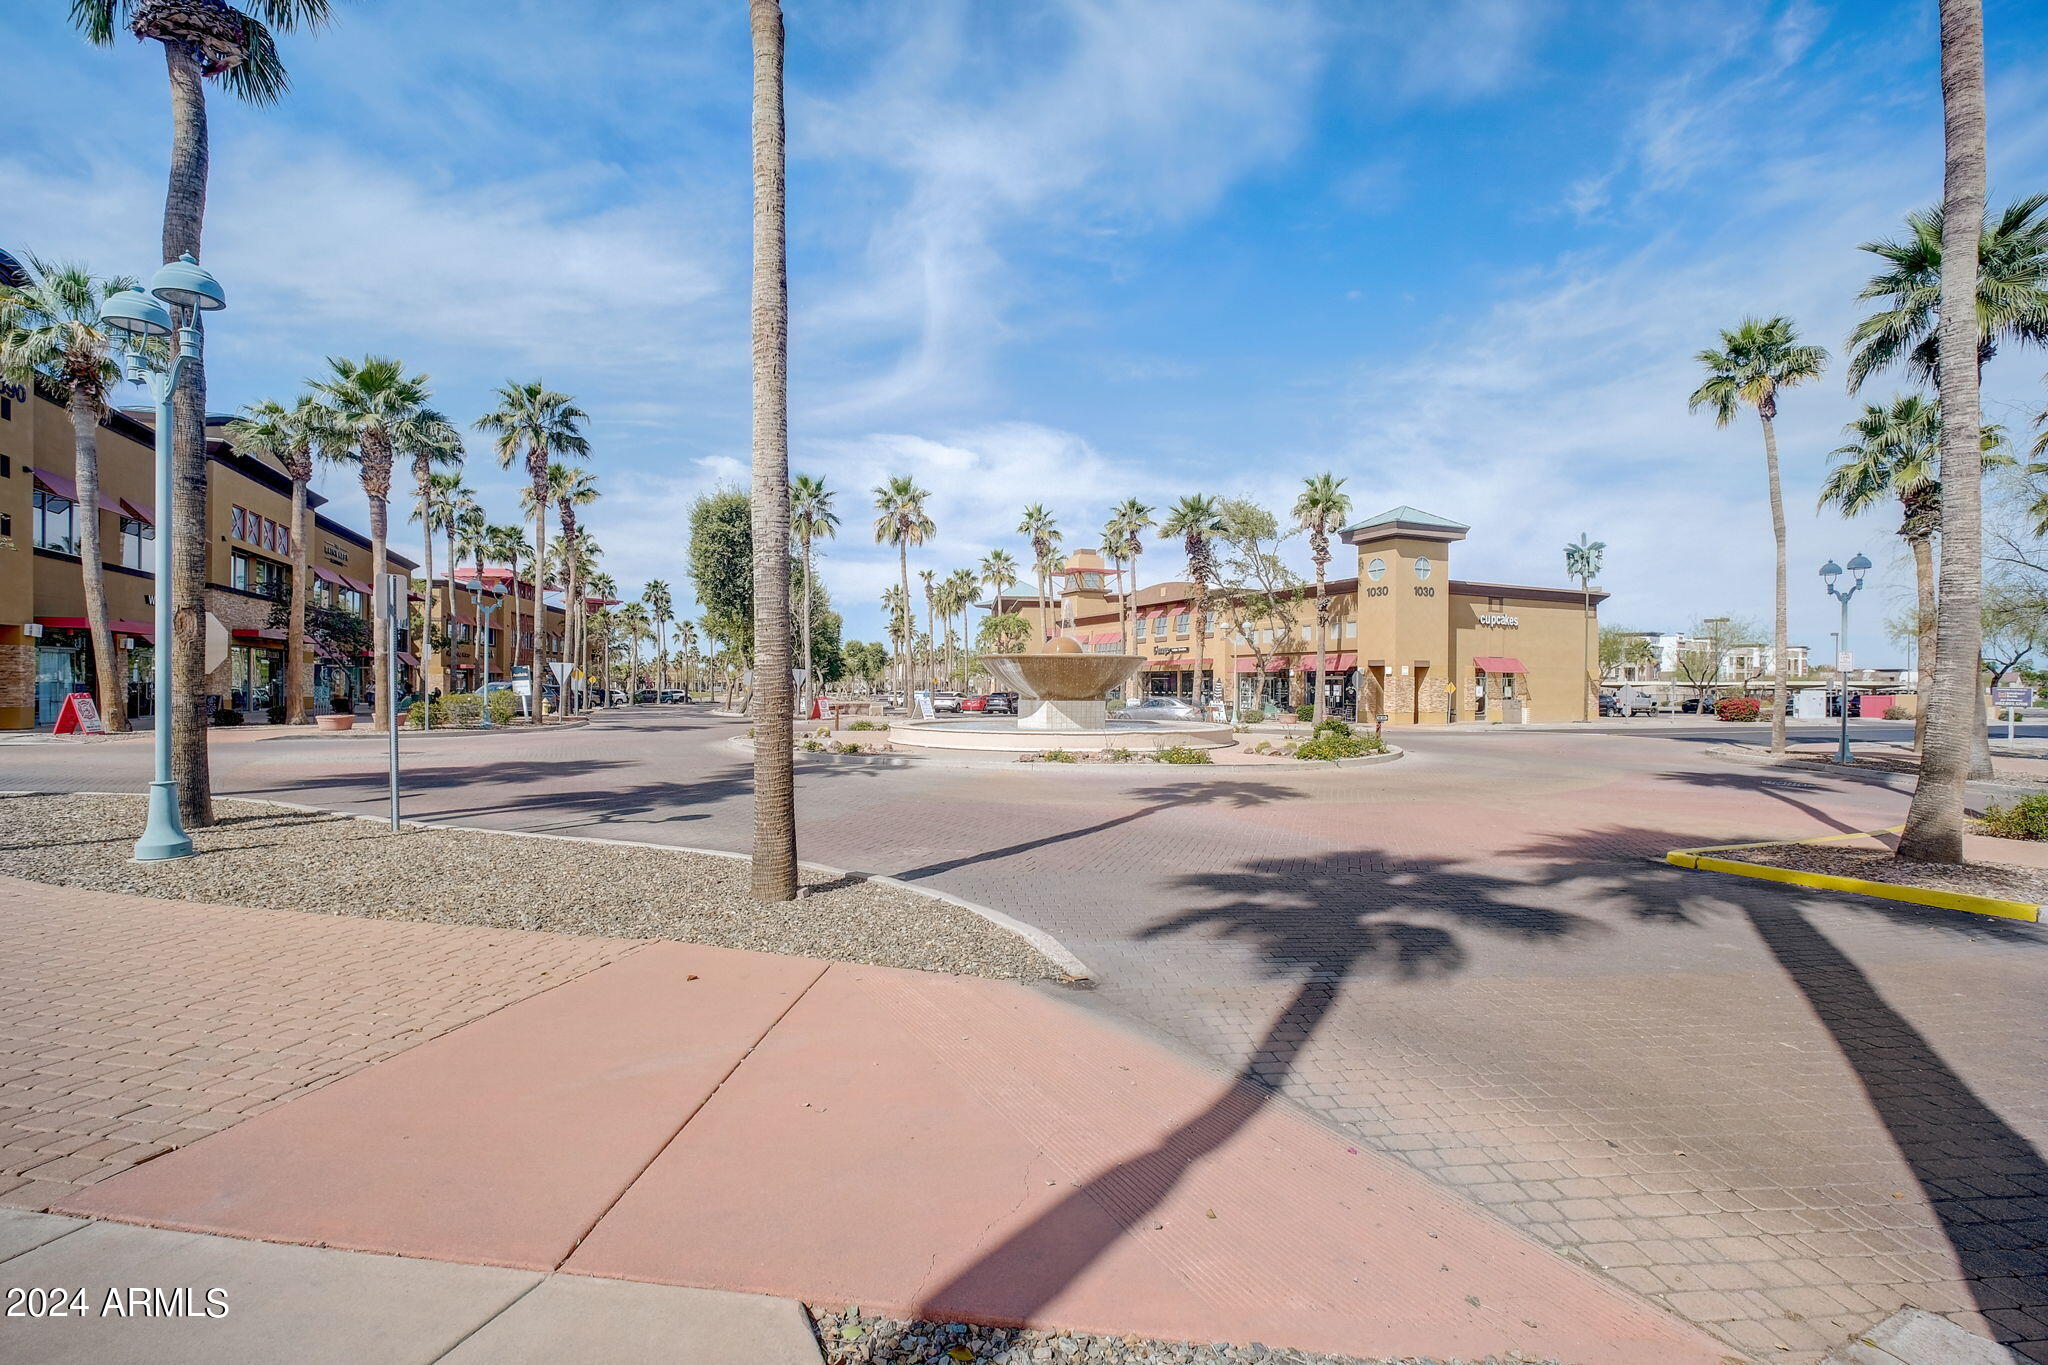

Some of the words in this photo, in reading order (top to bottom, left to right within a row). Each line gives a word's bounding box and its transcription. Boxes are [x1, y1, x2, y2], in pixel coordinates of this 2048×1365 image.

[1366, 586, 1389, 597] 1030
[1414, 586, 1435, 597] 1030
[1480, 613, 1519, 627] cupcakes
